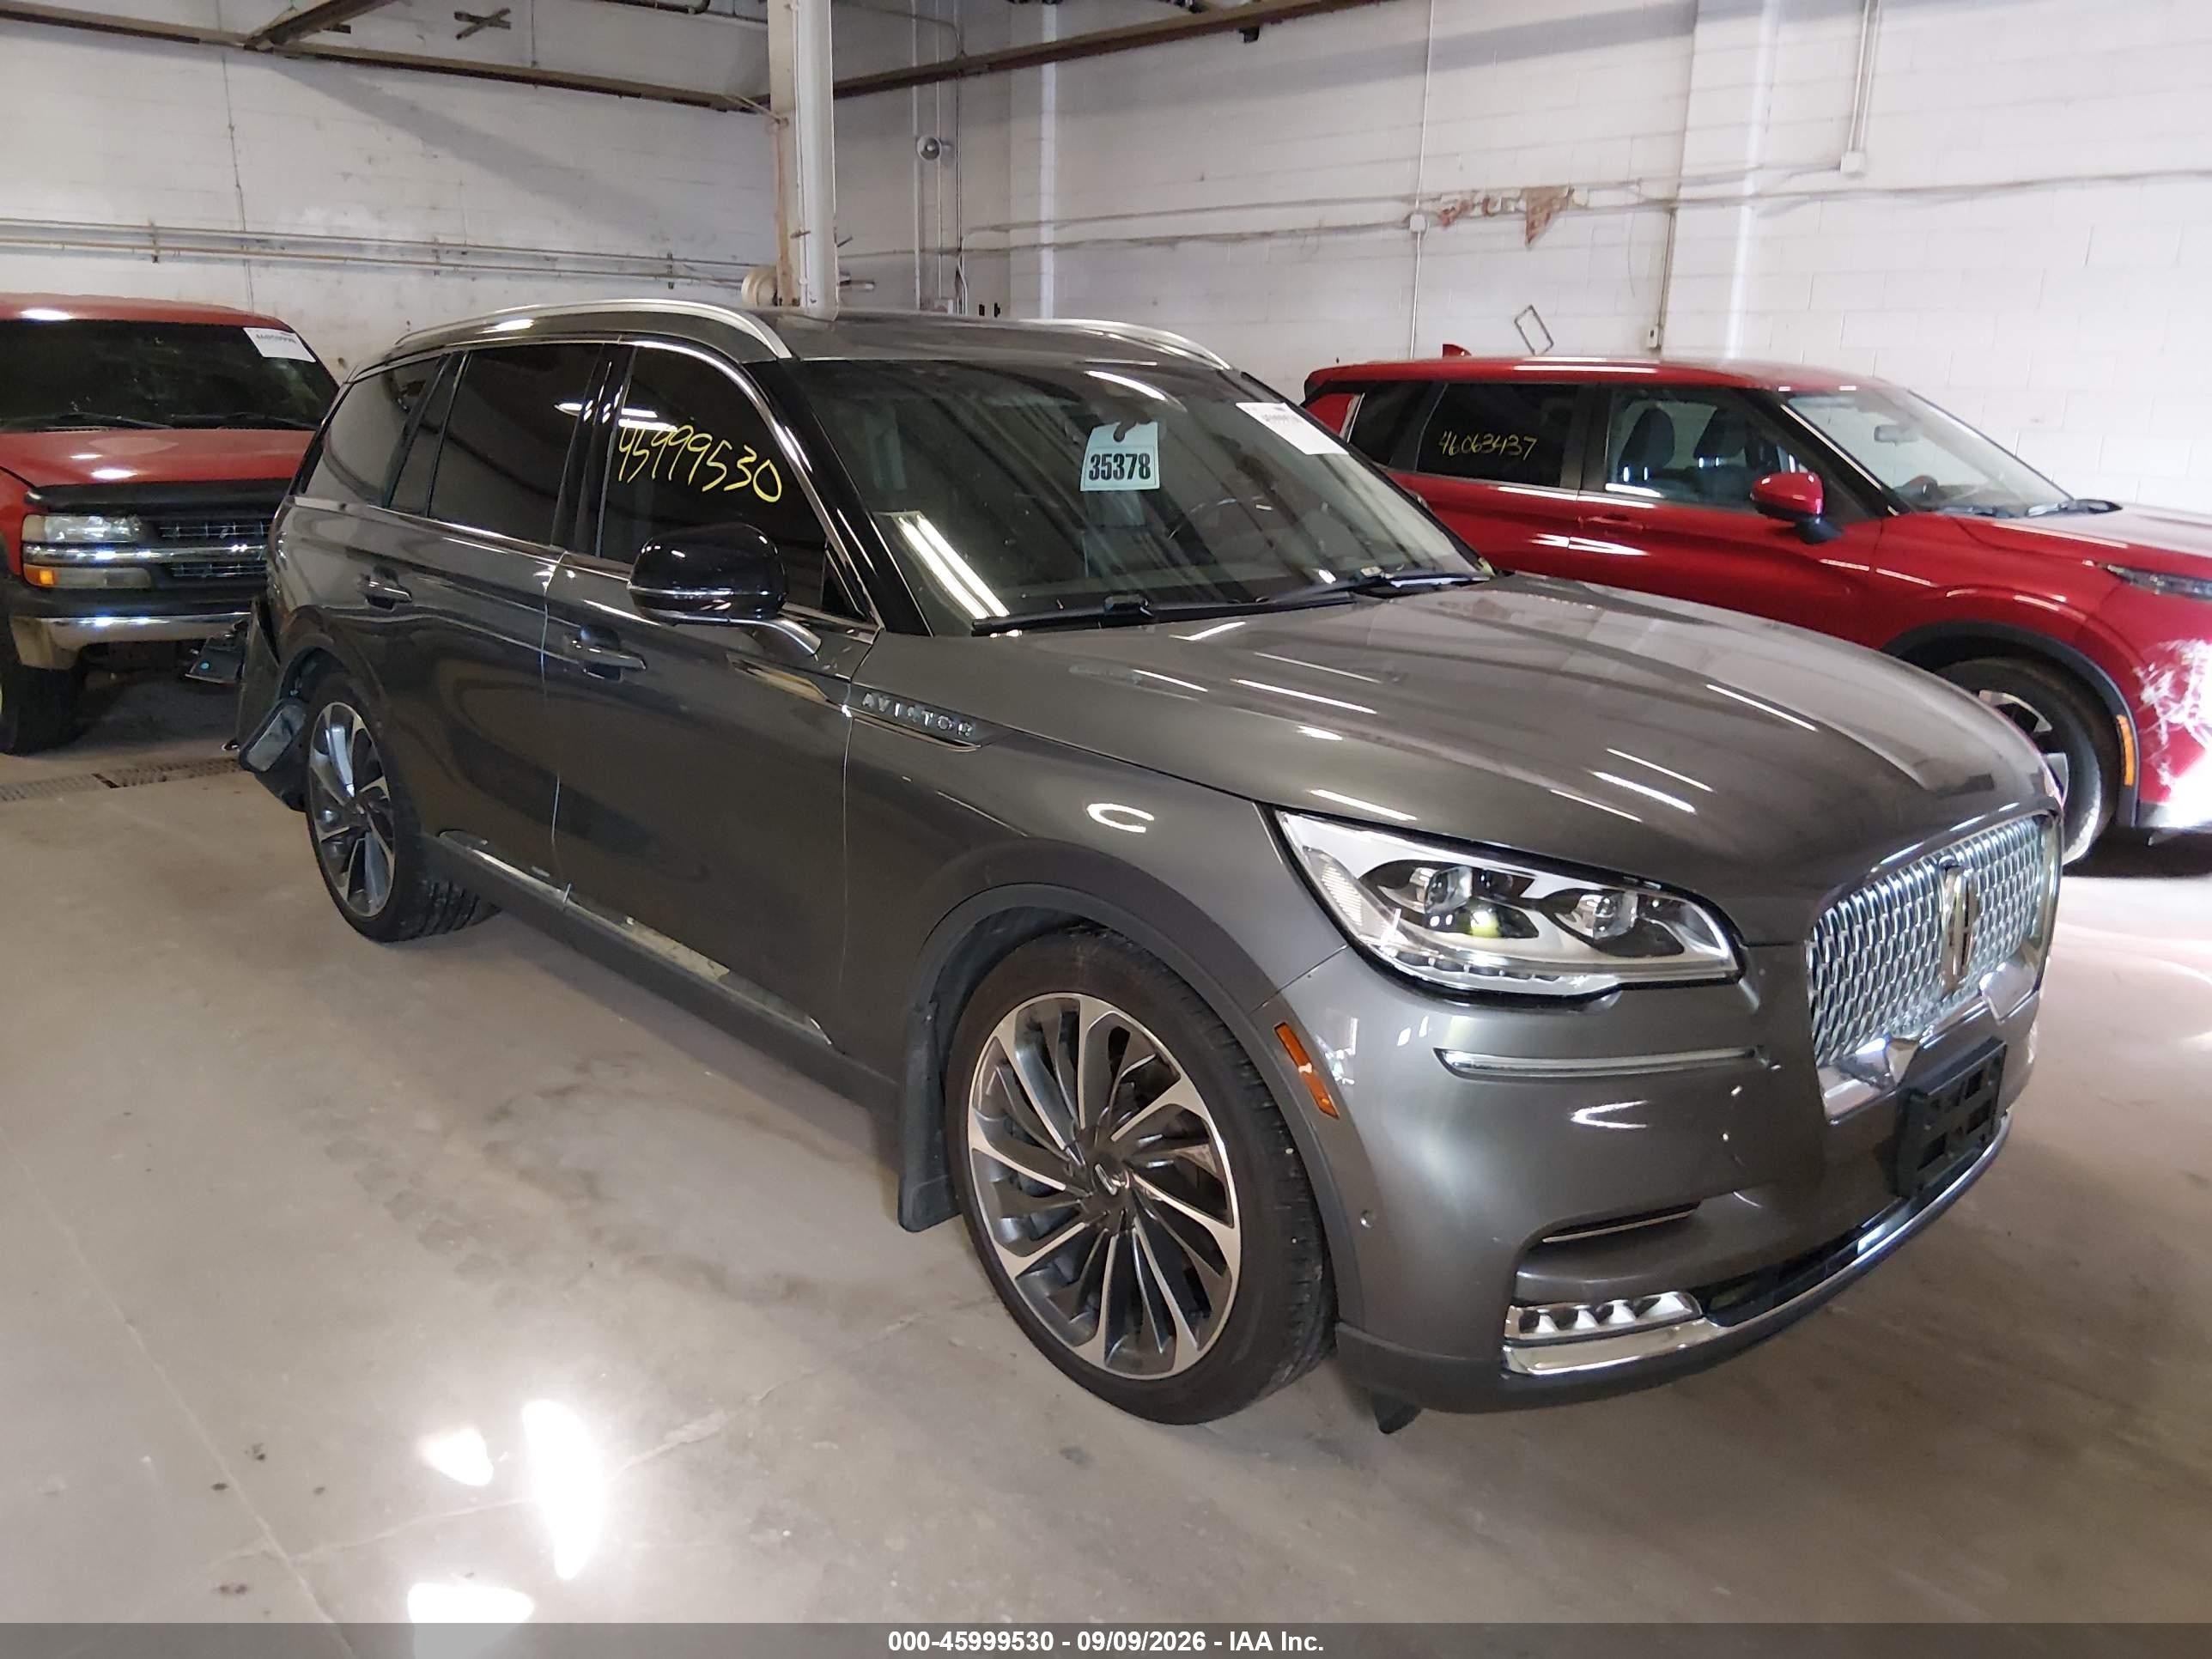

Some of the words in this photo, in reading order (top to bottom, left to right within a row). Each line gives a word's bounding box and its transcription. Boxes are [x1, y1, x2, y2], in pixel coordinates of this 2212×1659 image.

[618, 424, 783, 503] 45999530
[1438, 430, 1539, 461] 46063437
[1088, 452, 1152, 482] 35378
[860, 691, 974, 738] AVIATOR
